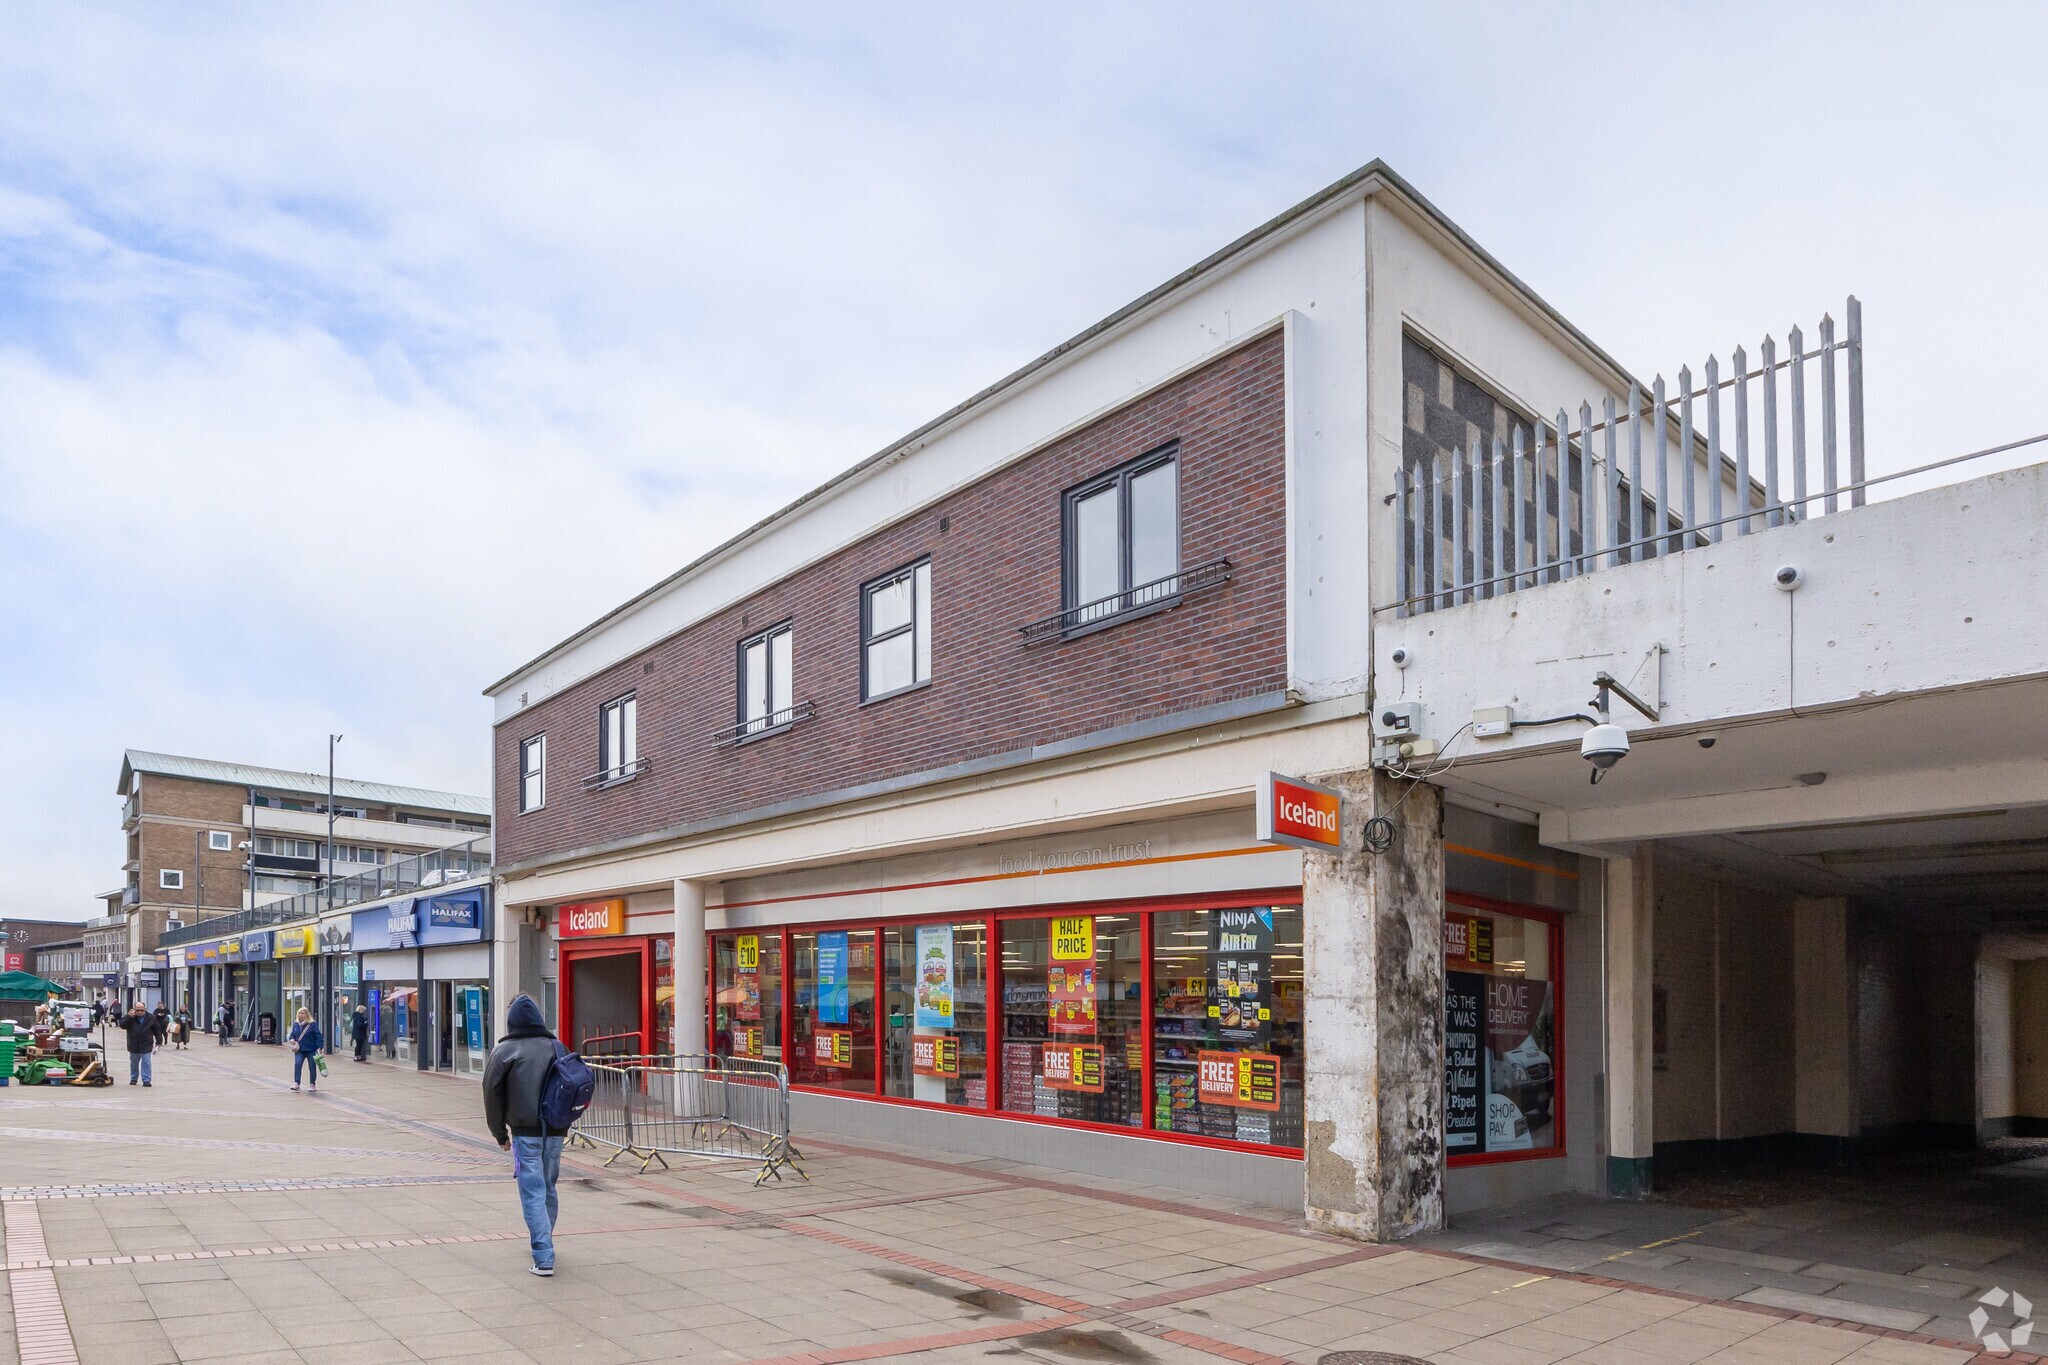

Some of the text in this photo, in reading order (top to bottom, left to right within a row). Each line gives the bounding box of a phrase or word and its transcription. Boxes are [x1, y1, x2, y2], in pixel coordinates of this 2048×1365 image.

[1280, 795, 1336, 832] Iceland
[998, 838, 1152, 875] food you can trust
[431, 907, 472, 918] HALIFAX
[570, 905, 609, 931] Iceland
[1220, 910, 1257, 930] NINJA
[387, 914, 416, 933] HALIFAX
[1059, 919, 1083, 935] HALF
[1057, 938, 1086, 954] PRICE
[1445, 943, 1466, 955] ELIVERY
[740, 946, 756, 965] £10
[1446, 994, 1477, 1010] AS THE
[1488, 983, 1528, 1008] HOME
[1453, 1010, 1477, 1028] WAS
[1488, 1008, 1528, 1025] DELIVERY
[735, 1032, 747, 1045] FREE
[816, 1036, 832, 1050] FREE
[914, 1042, 934, 1059] FREE
[1044, 1051, 1070, 1070] FREE
[1045, 1068, 1070, 1079] DELIVERY
[1201, 1060, 1235, 1083] FREE
[1201, 1080, 1234, 1093] DELIVERY
[1451, 1094, 1477, 1111] Piped
[1446, 1111, 1477, 1128] Created
